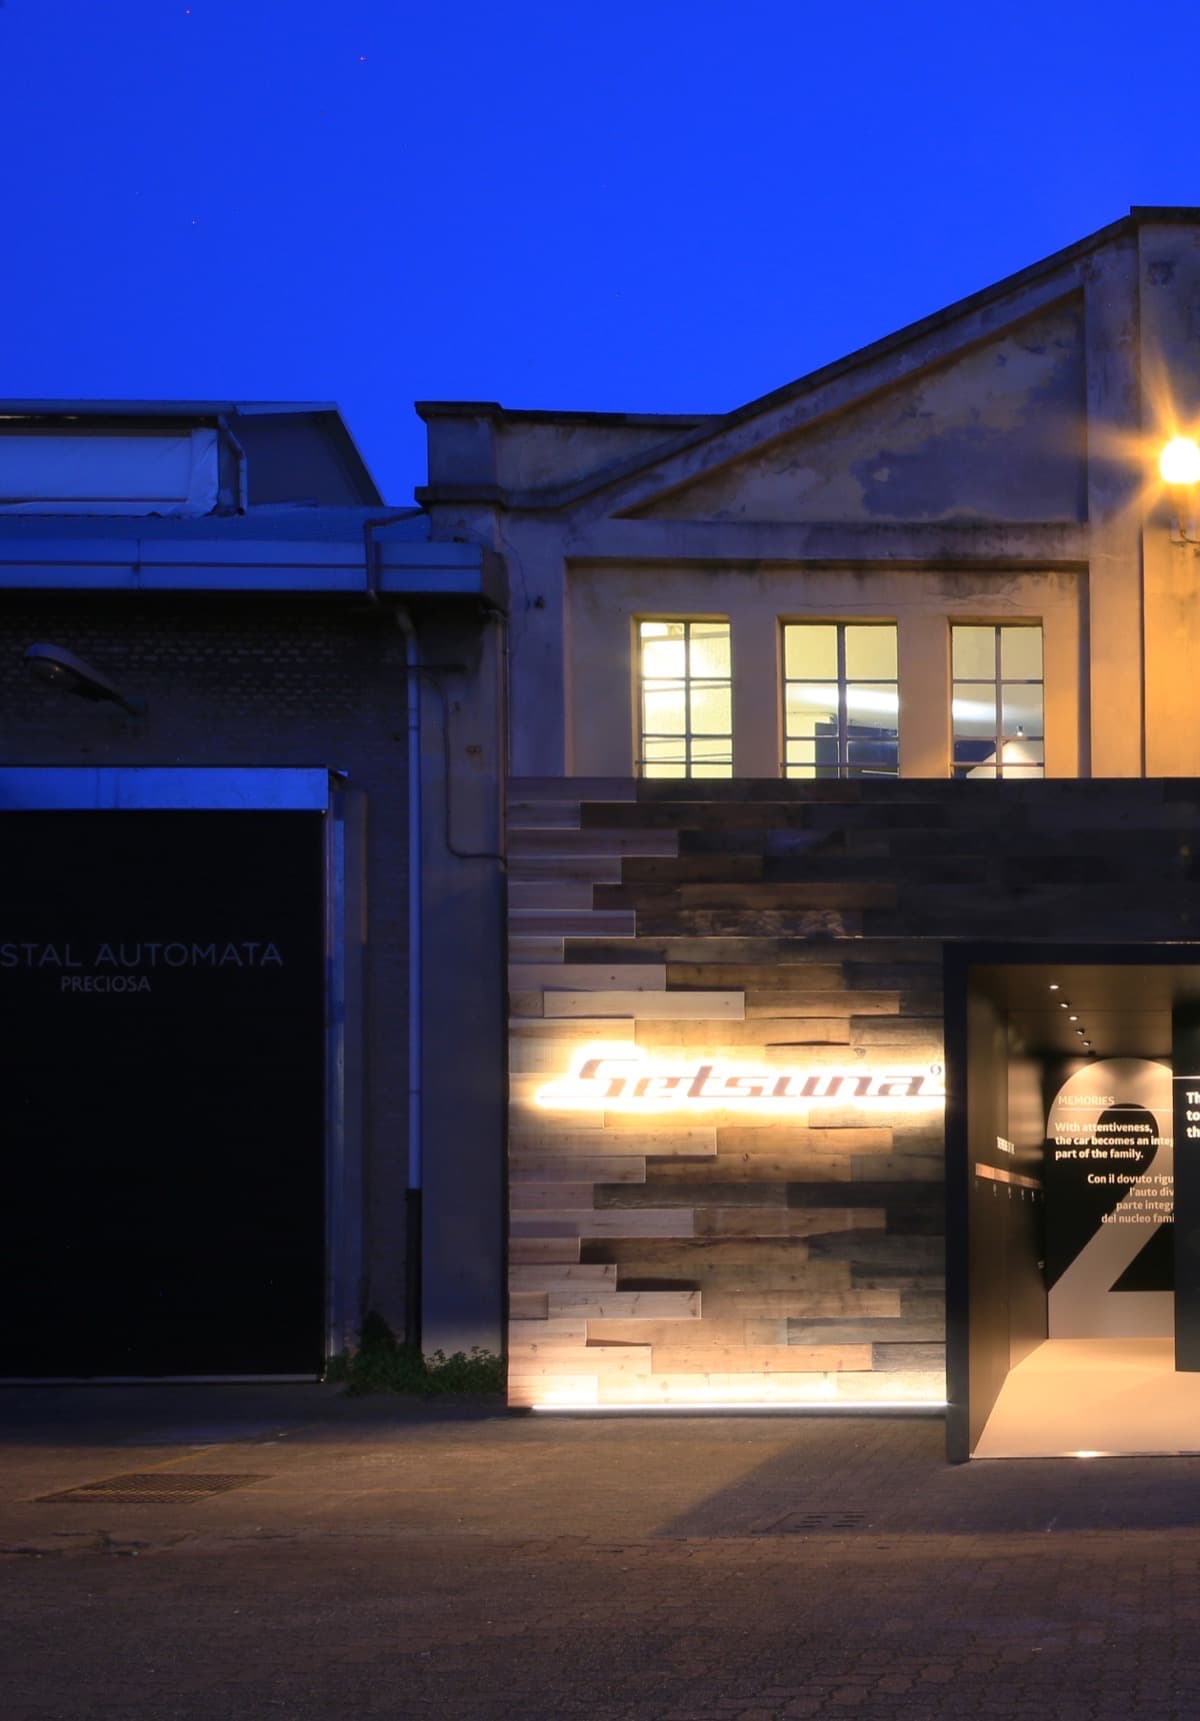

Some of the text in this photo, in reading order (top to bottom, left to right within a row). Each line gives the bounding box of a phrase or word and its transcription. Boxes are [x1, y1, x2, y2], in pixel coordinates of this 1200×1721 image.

[0, 942, 284, 967] STAL AUTOMATA
[61, 975, 153, 993] PRECIOSA
[1058, 1096, 1115, 1105] MEMORIES
[1186, 1109, 1200, 1121] to
[1055, 1122, 1153, 1134] With attentiveness,
[1055, 1136, 1072, 1146] the
[1073, 1137, 1089, 1146] car
[1091, 1136, 1135, 1146] becomes
[1137, 1137, 1149, 1146] an
[1055, 1148, 1144, 1161] part of the family.
[1087, 1173, 1174, 1186] Con il dovuto rigu
[1129, 1187, 1158, 1197] l'auto
[1116, 1201, 1143, 1212] parte
[1101, 1213, 1175, 1224] del nucleo fami
